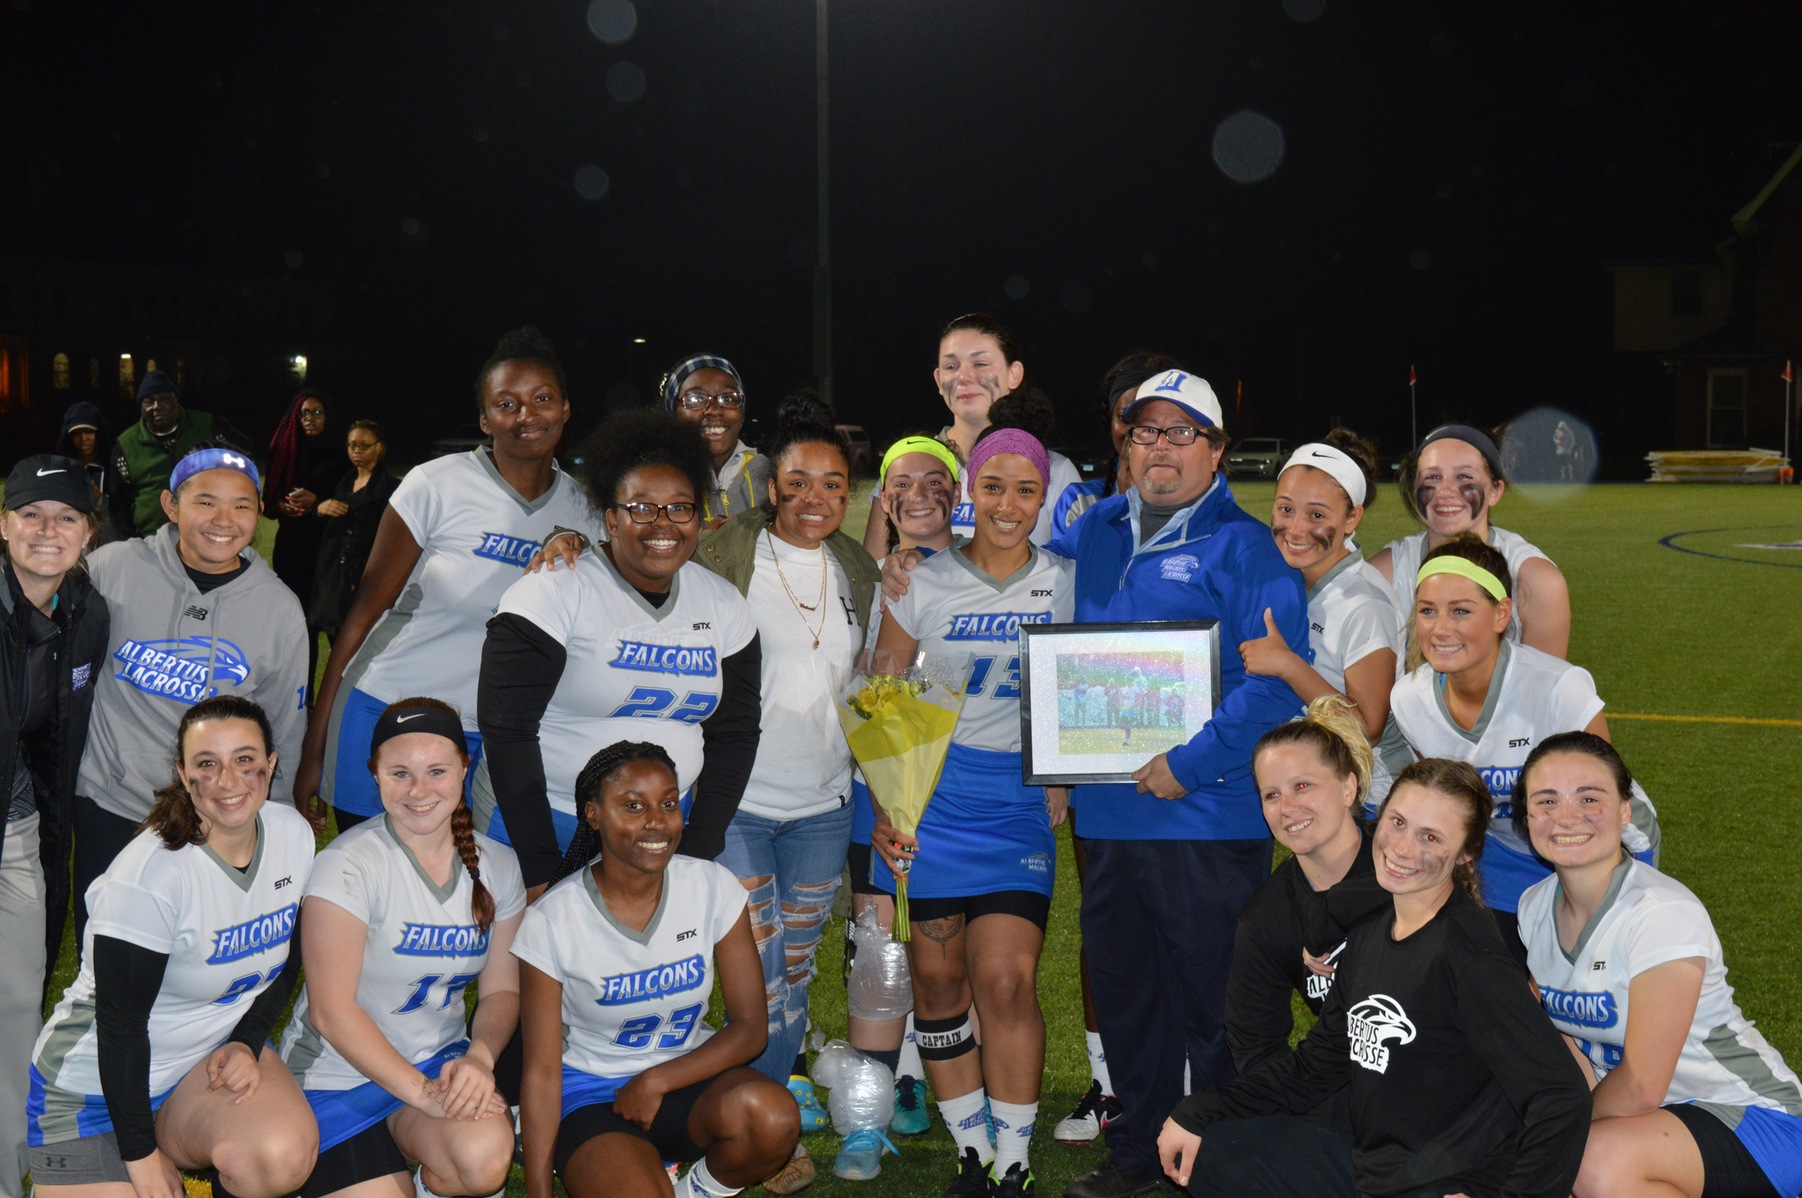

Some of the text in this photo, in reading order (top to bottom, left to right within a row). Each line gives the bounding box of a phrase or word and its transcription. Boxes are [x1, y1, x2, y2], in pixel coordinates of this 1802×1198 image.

[693, 622, 711, 630] STX
[1310, 622, 1325, 635] STX
[117, 641, 209, 683] ALBERTUS
[618, 643, 714, 672] FALCONS
[606, 686, 719, 726] 22
[1509, 737, 1530, 748] STX
[274, 875, 293, 890] STX
[215, 908, 294, 958] FALCONS
[676, 928, 698, 942] STX
[1592, 961, 1606, 970] ST
[605, 958, 700, 1001] FALCONS
[609, 1001, 704, 1050] 23
[922, 1031, 962, 1047] CAPTAIN
